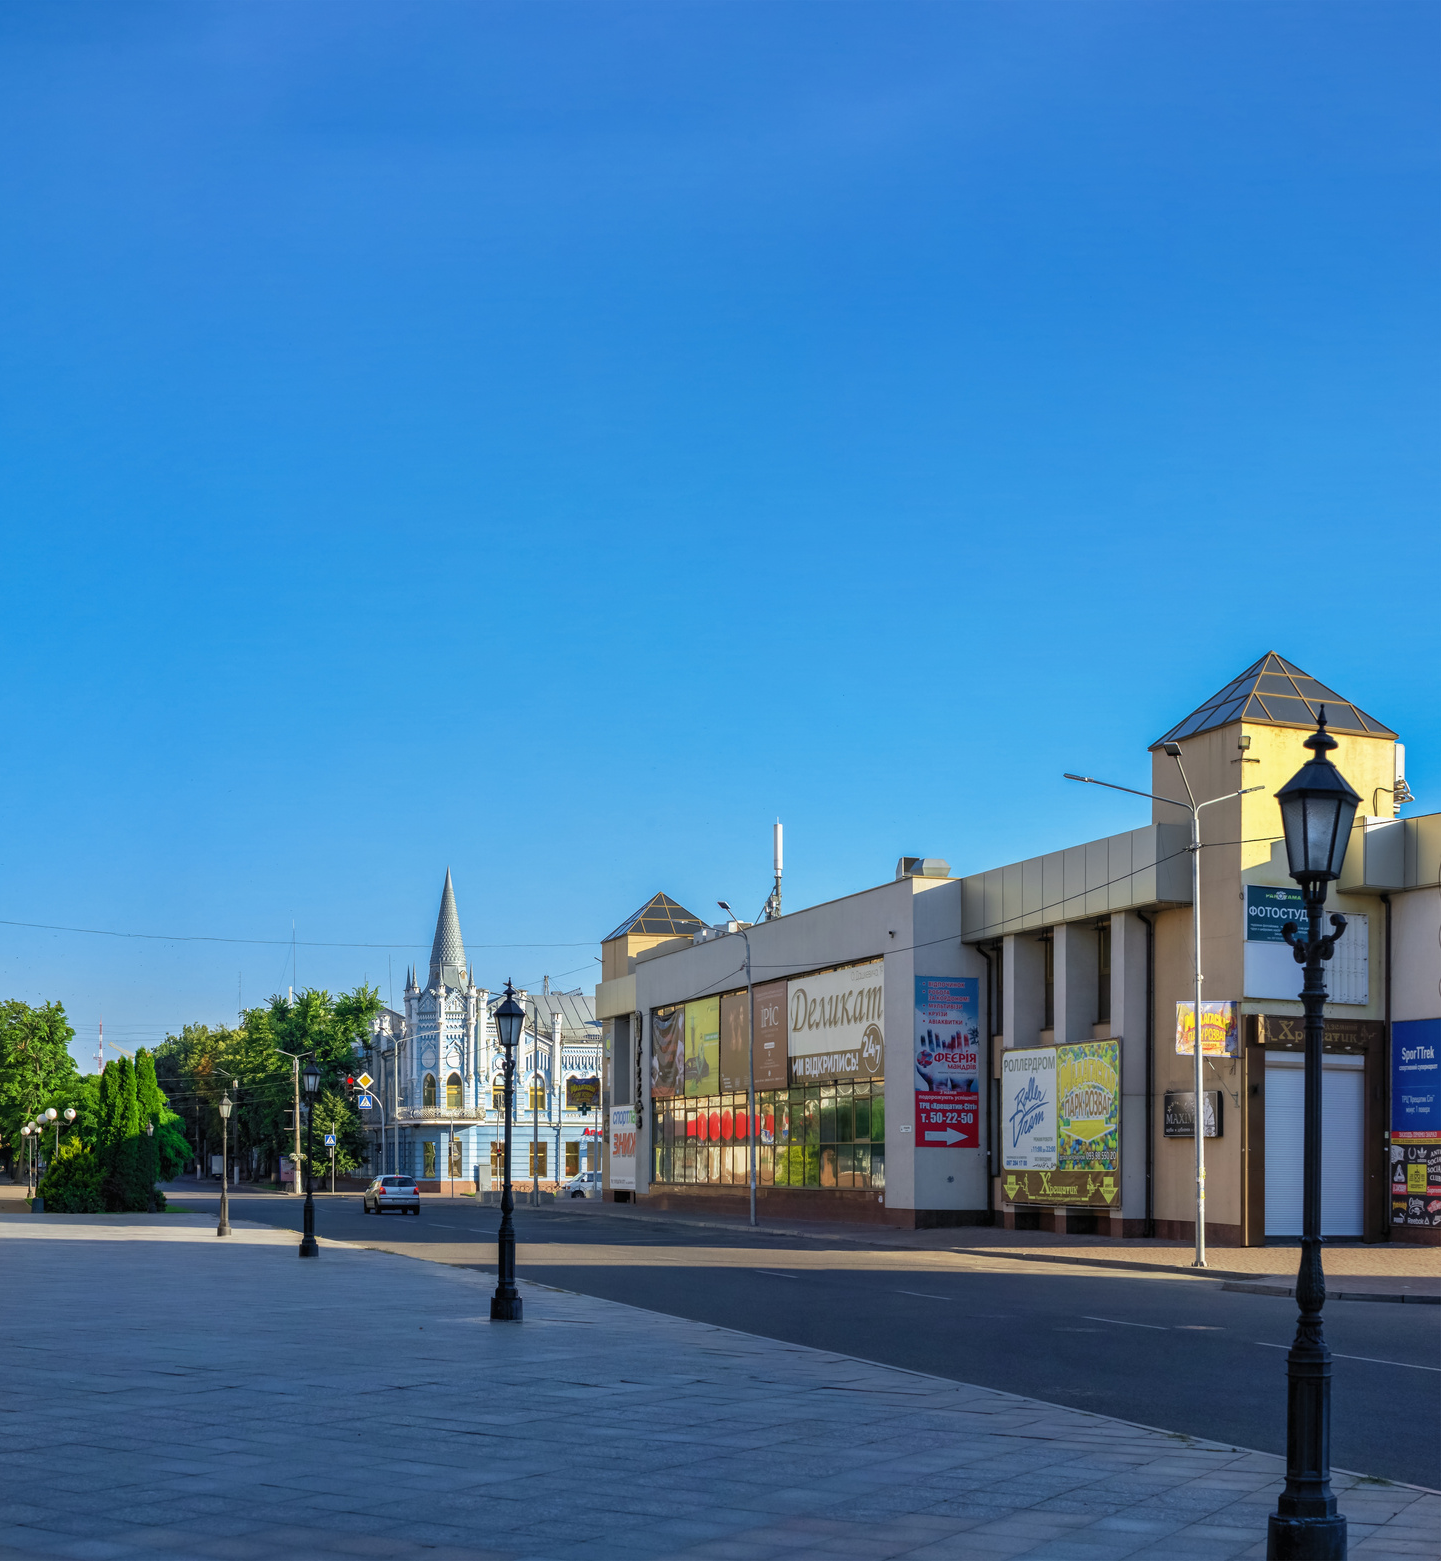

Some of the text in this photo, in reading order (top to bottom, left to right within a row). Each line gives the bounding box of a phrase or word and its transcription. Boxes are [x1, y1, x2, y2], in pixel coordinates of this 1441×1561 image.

[1248, 905, 1309, 923] ФОТОСТУД
[928, 981, 965, 989] ВІДПОЧИНОК
[791, 985, 883, 1033] Деликат
[1278, 1020, 1358, 1044] Хратик
[934, 1050, 977, 1065] ФЕЄРІЯ
[1401, 1045, 1435, 1064] SporTTrek
[805, 1052, 859, 1079] ВІДКРИЛИСЬ!
[1004, 1056, 1056, 1075] РОЛЛЕРДРОМ
[1059, 1056, 1117, 1103] МАДАГАСКАР
[919, 1102, 930, 1111] ТРЦ
[1064, 1090, 1113, 1118] ПАРК РОЗВАГ
[930, 1112, 974, 1124] 50-22-50
[1039, 1172, 1079, 1197] Хрещатик
